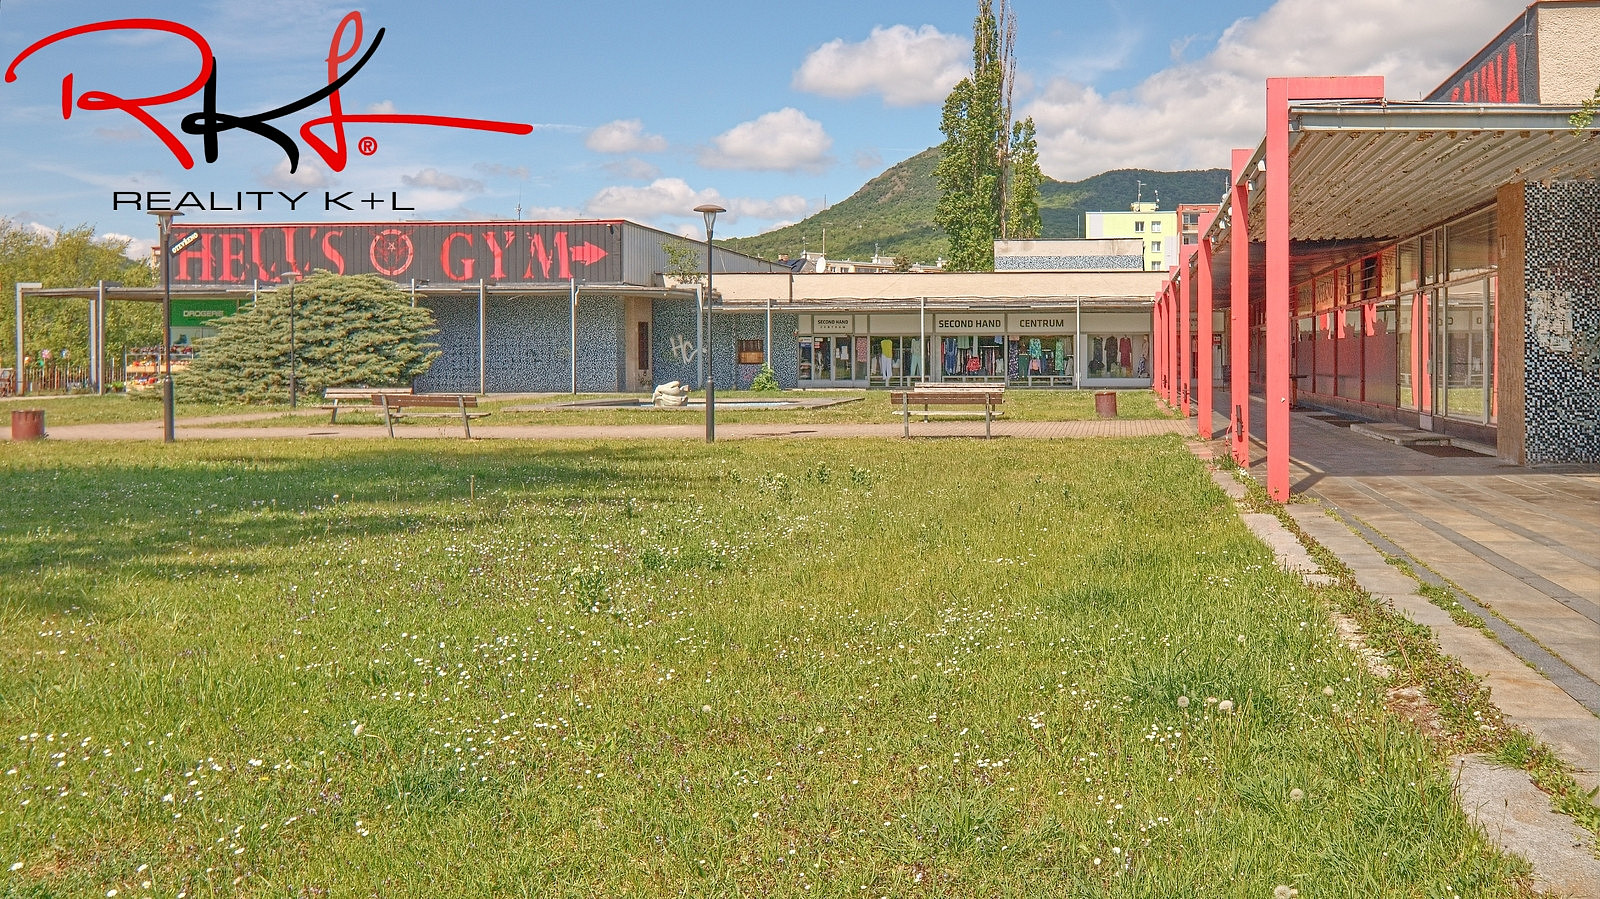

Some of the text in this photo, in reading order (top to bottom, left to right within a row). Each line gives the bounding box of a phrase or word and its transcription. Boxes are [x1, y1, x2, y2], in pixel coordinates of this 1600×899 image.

[174, 227, 574, 283] HELL'S GYM
[938, 319, 1064, 328] SECOND HAND CENTRUM
